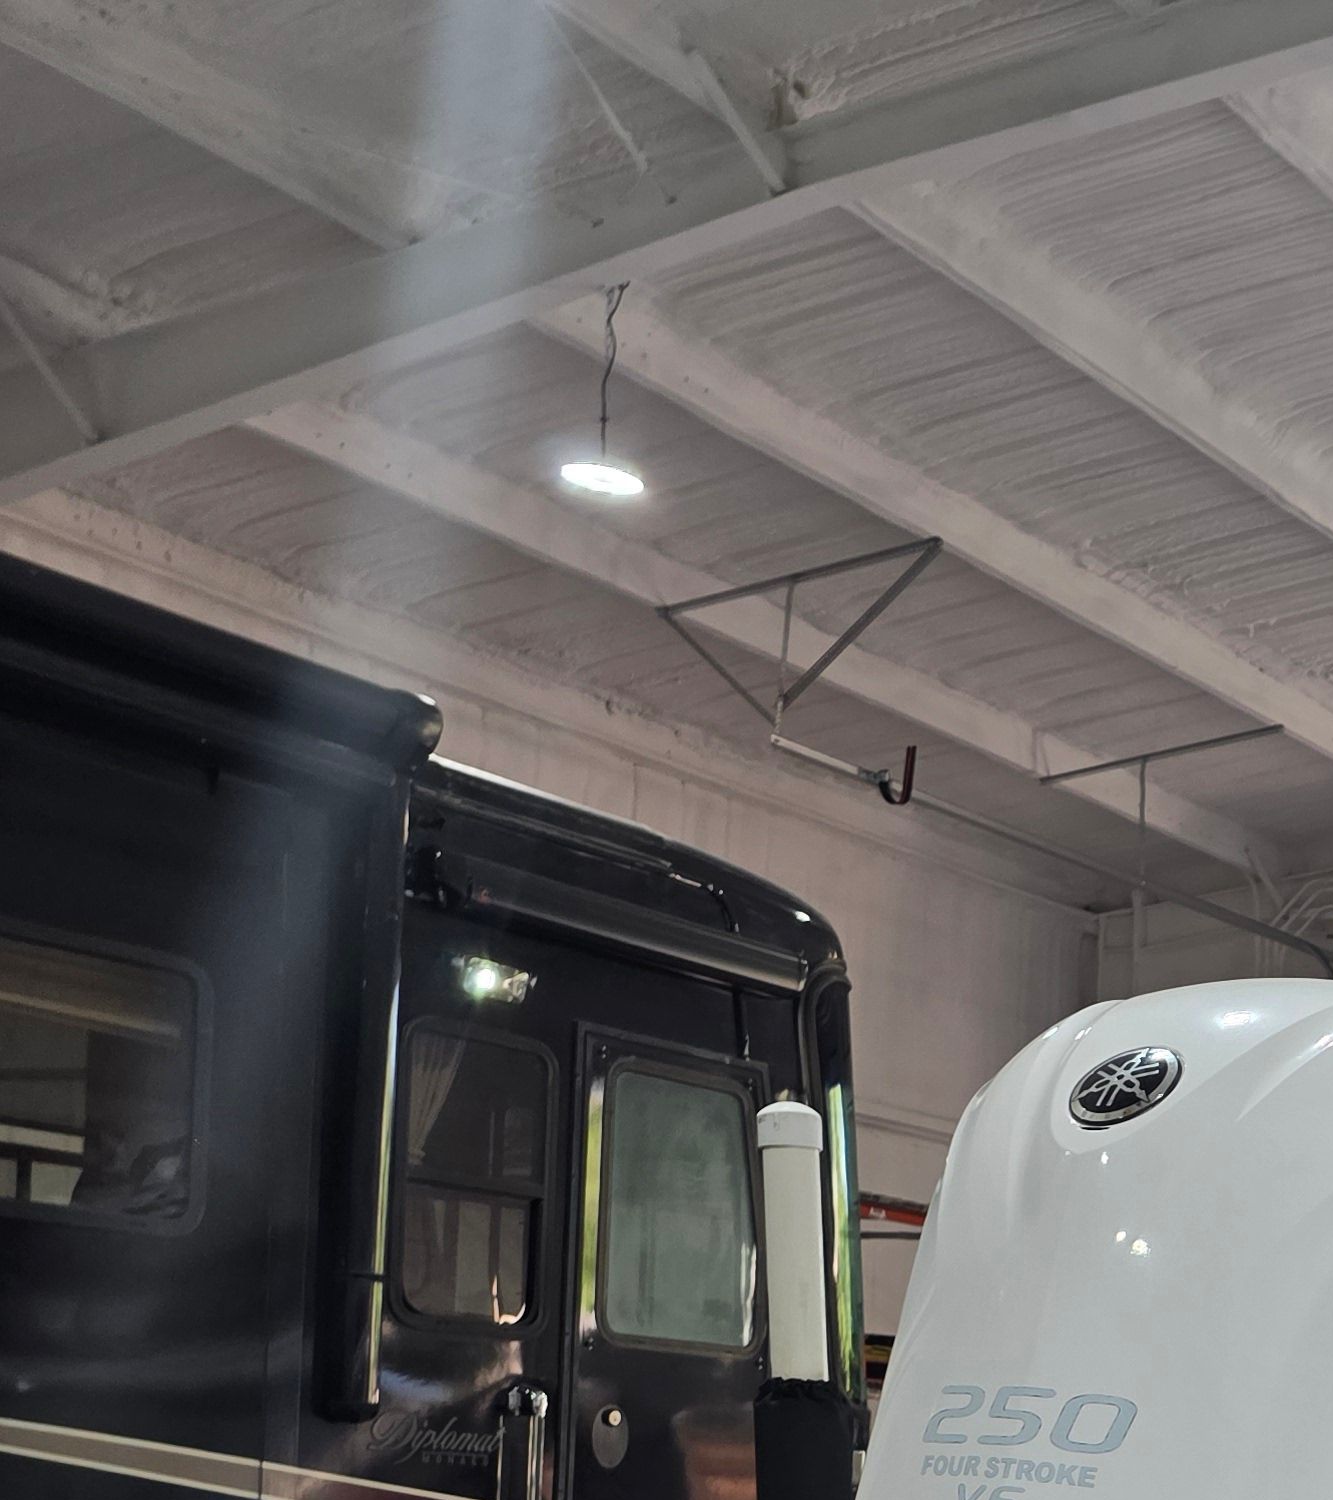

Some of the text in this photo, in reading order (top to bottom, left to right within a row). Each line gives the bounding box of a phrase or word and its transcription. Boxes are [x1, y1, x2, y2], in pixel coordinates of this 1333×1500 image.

[366, 1413, 506, 1466] Diplomat
[922, 1385, 1139, 1454] 250
[920, 1455, 1098, 1489] FOUR STROKE
